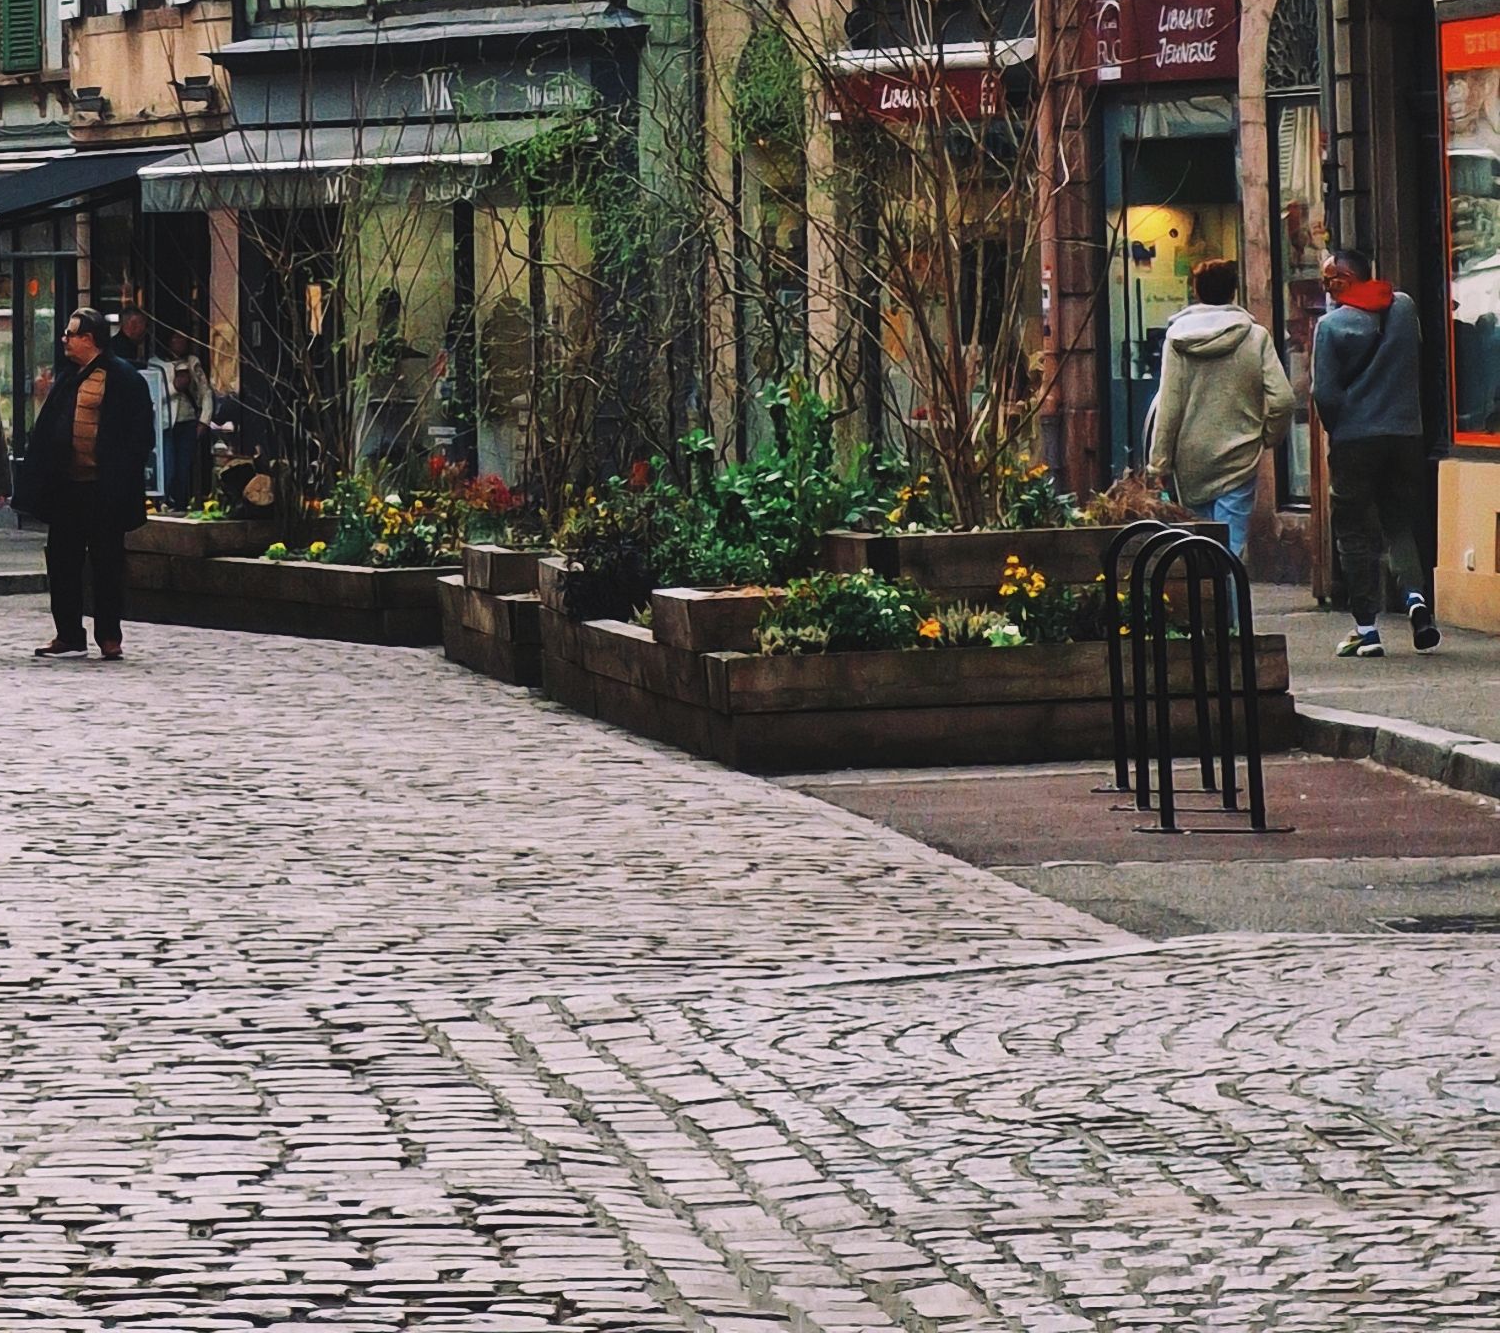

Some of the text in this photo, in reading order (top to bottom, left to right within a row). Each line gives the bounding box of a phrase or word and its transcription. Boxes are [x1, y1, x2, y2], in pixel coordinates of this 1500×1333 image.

[1158, 5, 1216, 32] LIBRAIRIE
[1156, 37, 1218, 68] JEUNESSE
[421, 72, 453, 112] MK
